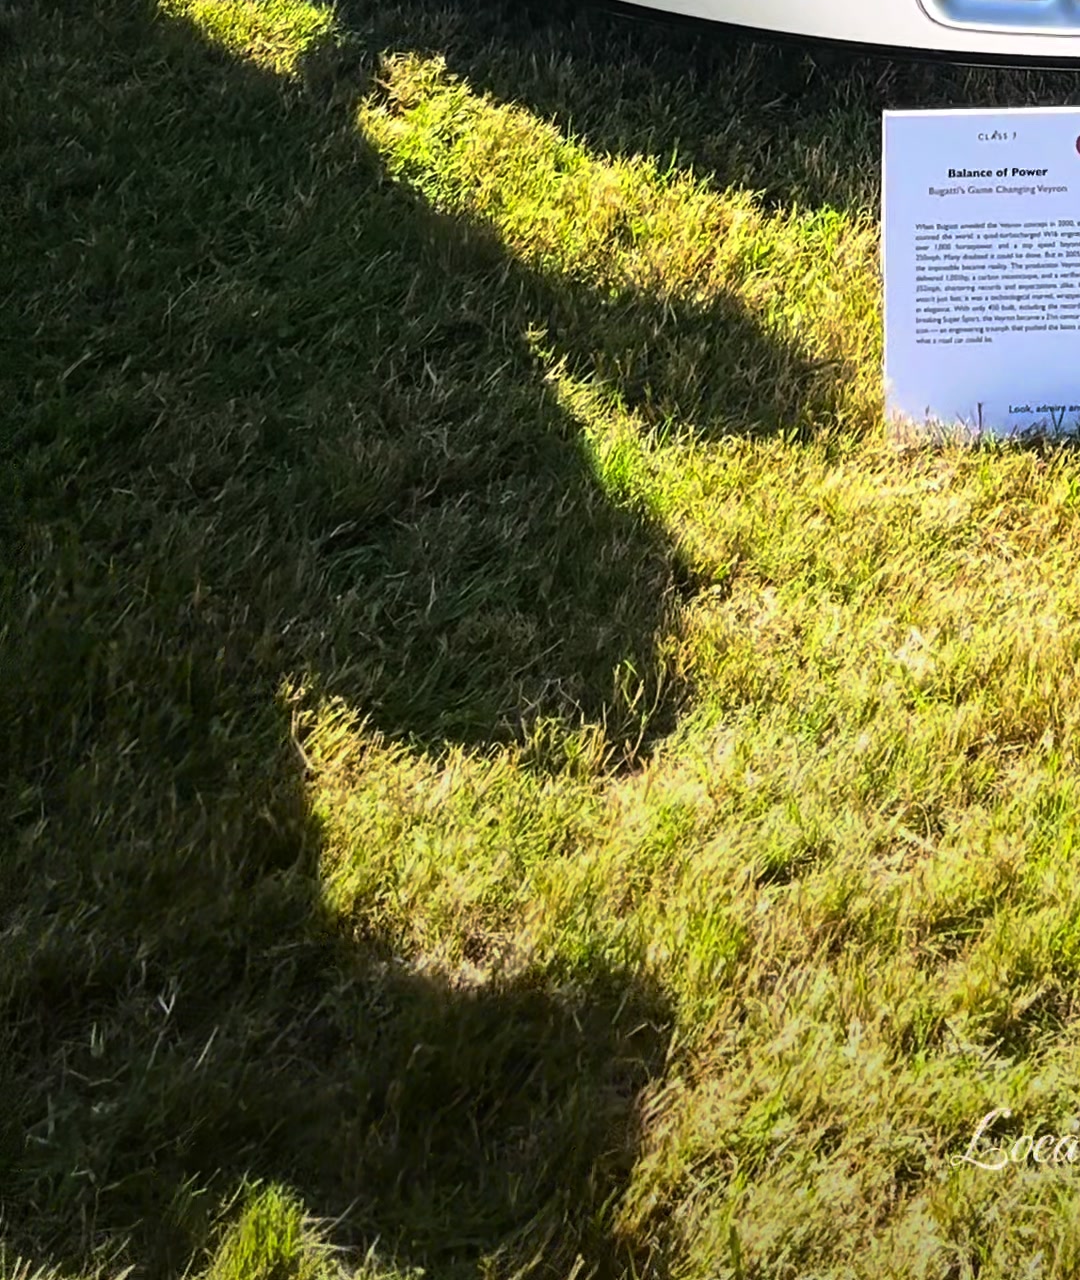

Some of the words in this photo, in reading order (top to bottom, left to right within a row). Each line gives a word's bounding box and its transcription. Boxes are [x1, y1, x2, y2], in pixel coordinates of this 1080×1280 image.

[948, 169, 993, 178] Balance
[995, 168, 1008, 177] of
[1011, 168, 1048, 177] Power
[928, 187, 965, 197] Bugatti's
[995, 185, 1036, 195] Changing
[1037, 185, 1068, 194] Veyron
[1008, 404, 1033, 414] Look,
